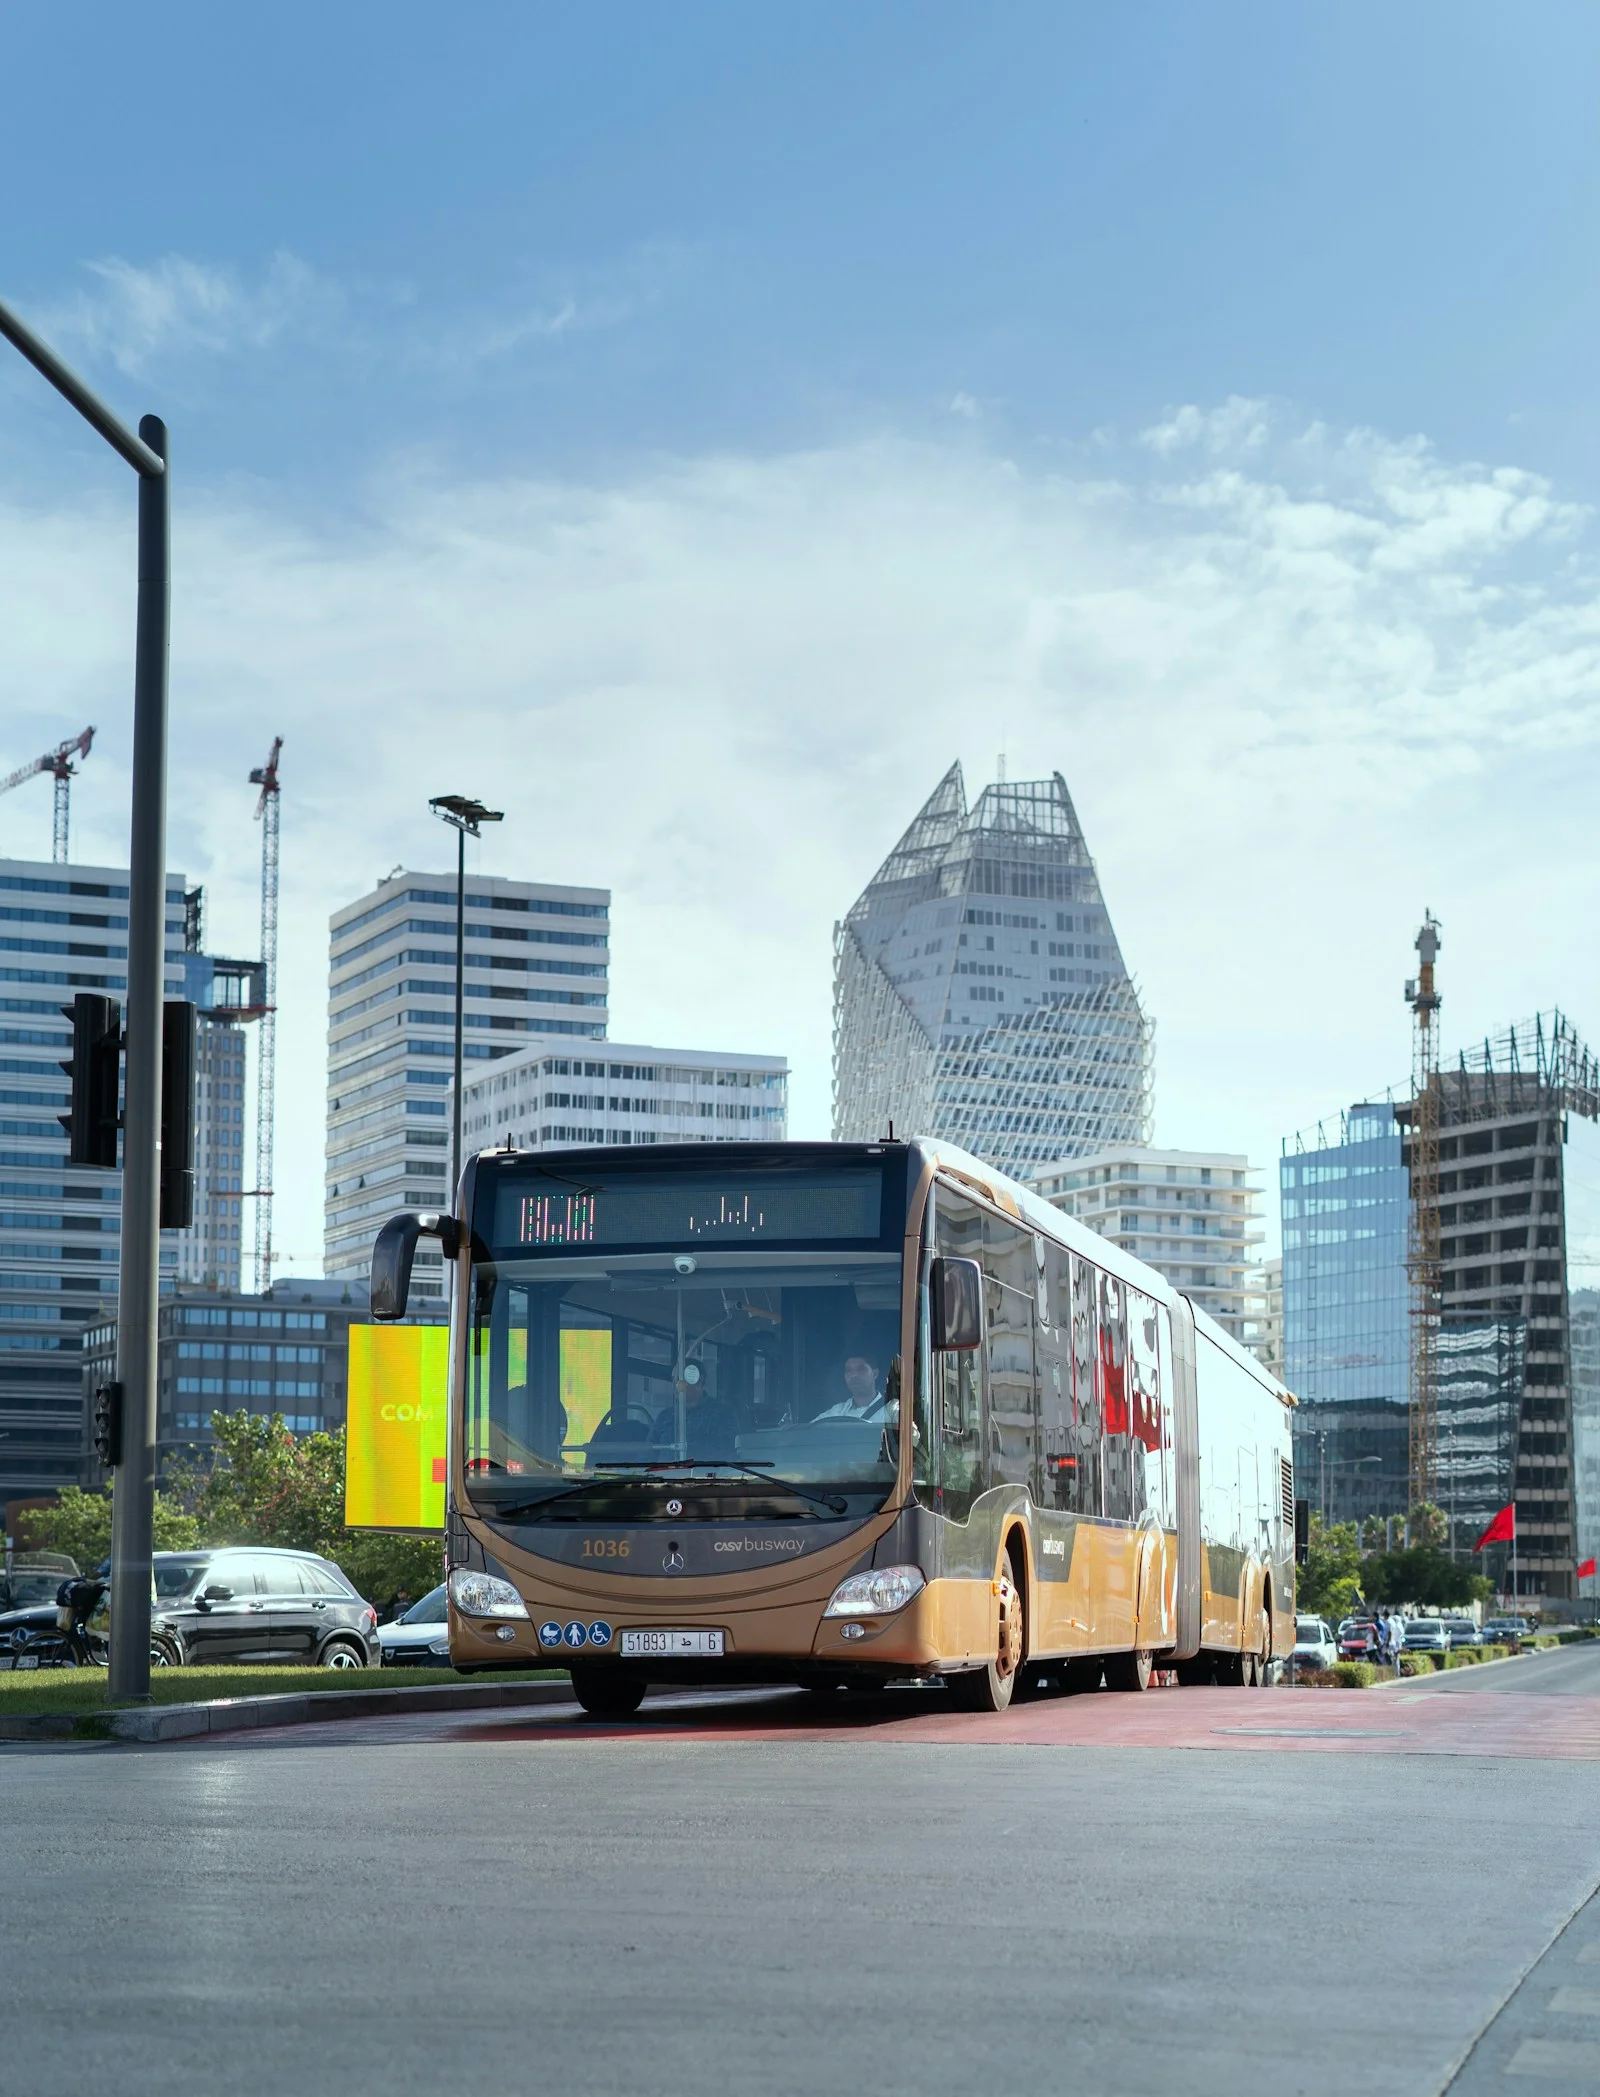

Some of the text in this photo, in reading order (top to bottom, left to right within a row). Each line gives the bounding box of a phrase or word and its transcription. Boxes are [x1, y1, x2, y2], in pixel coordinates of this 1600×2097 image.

[582, 1539, 630, 1557] 1036
[627, 1633, 666, 1651] 51893
[708, 1633, 716, 1650] 6
